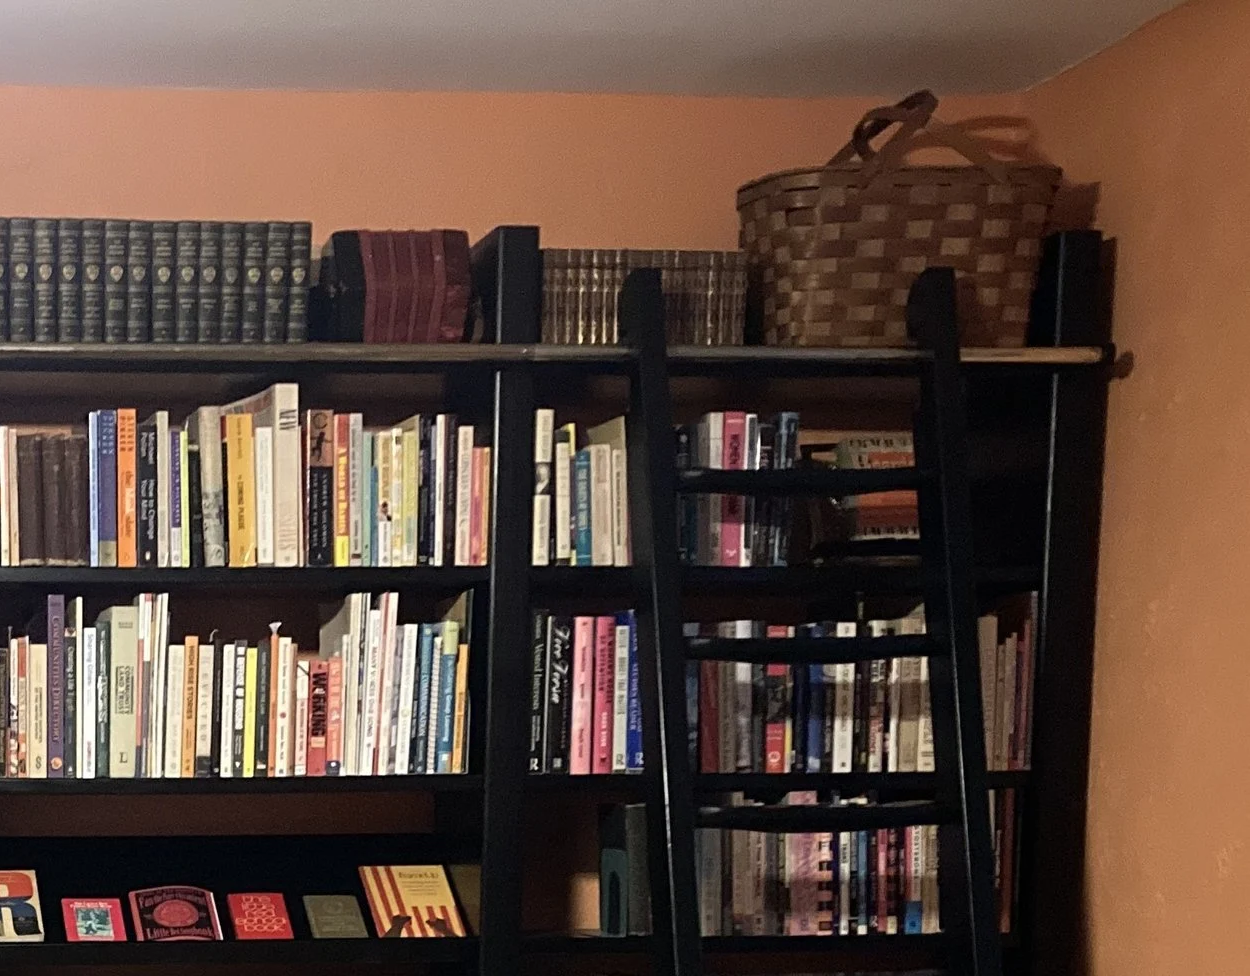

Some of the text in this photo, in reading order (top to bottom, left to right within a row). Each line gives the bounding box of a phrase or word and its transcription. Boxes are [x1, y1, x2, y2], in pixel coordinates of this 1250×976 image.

[279, 409, 298, 431] NEW
[117, 666, 125, 691] LAND
[124, 665, 132, 715] COMMUNITY
[186, 645, 195, 719] HIGH RISE STORIES
[311, 672, 327, 737] WORKING
